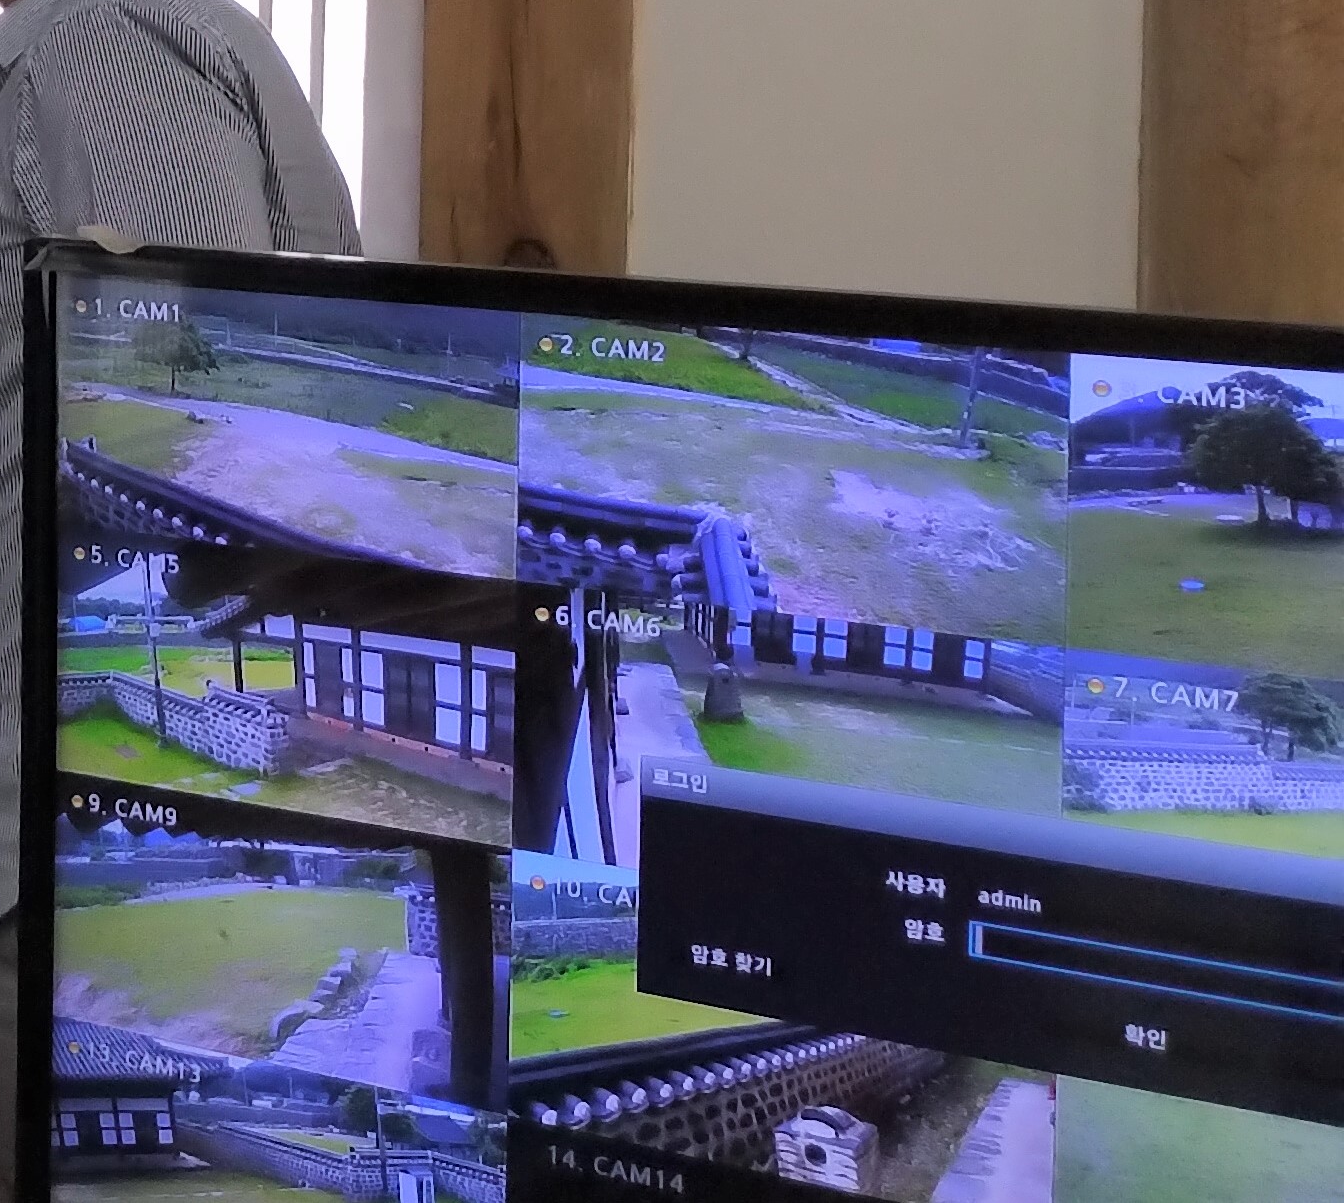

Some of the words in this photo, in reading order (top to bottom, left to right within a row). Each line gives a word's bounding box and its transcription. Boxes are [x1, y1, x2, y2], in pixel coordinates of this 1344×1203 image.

[95, 298, 111, 317] 1.
[119, 299, 179, 323] CAM1
[559, 333, 581, 357] 2.
[591, 337, 665, 362] CAM2
[1157, 384, 1246, 410] CAM3
[91, 544, 109, 567] 5.
[587, 609, 662, 637] CAM6
[1113, 676, 1138, 702] 7.
[1151, 681, 1239, 712] CAM7
[652, 768, 707, 794] 로그인
[88, 793, 107, 816] 9.
[115, 798, 177, 826] CAM9
[885, 870, 947, 899] 사용자
[977, 889, 1042, 913] admin
[904, 918, 946, 943] 암호
[691, 944, 729, 968] 암호
[735, 952, 772, 977] 찾기
[1124, 1023, 1167, 1051] 확인
[125, 1050, 201, 1084] CAM13
[548, 1144, 584, 1173] 14.
[593, 1156, 685, 1195] CAM14
